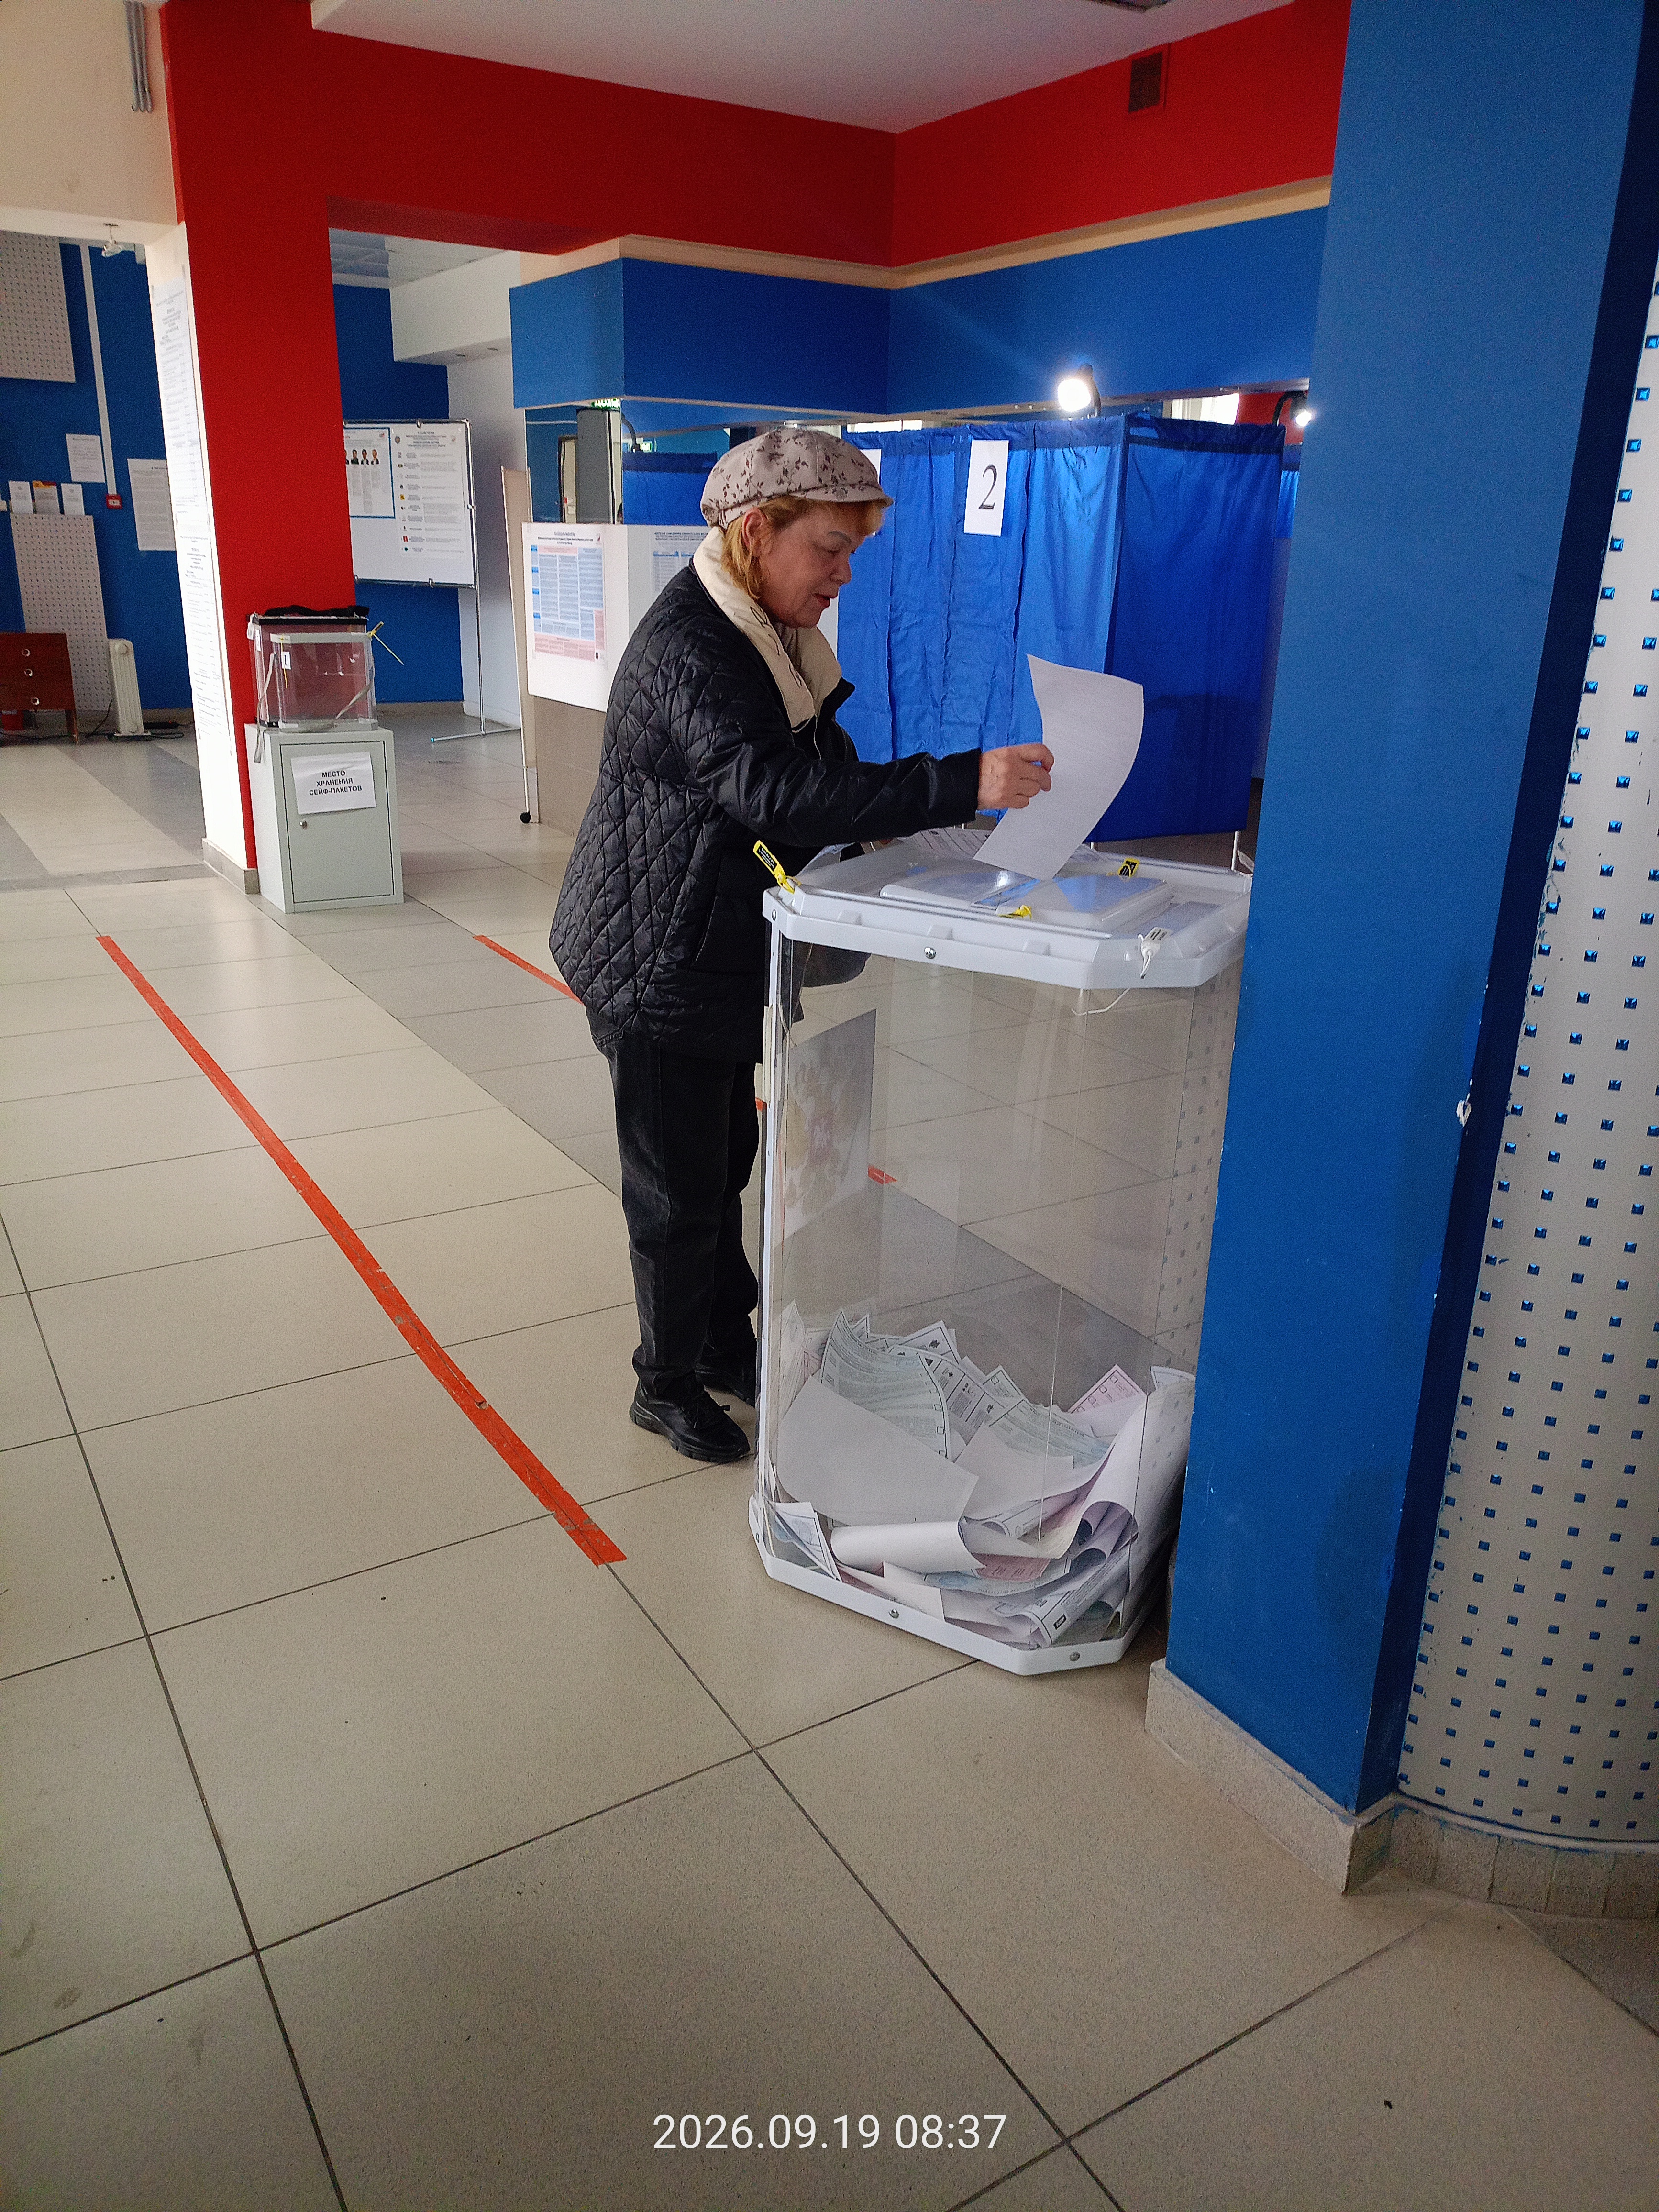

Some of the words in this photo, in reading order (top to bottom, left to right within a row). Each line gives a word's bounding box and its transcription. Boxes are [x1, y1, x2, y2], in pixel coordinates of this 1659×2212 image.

[979, 465, 997, 510] 2
[316, 778, 353, 786] ХРАНЕНИЯ
[309, 785, 362, 795] СЕЙФ-ПАКЕТОВ
